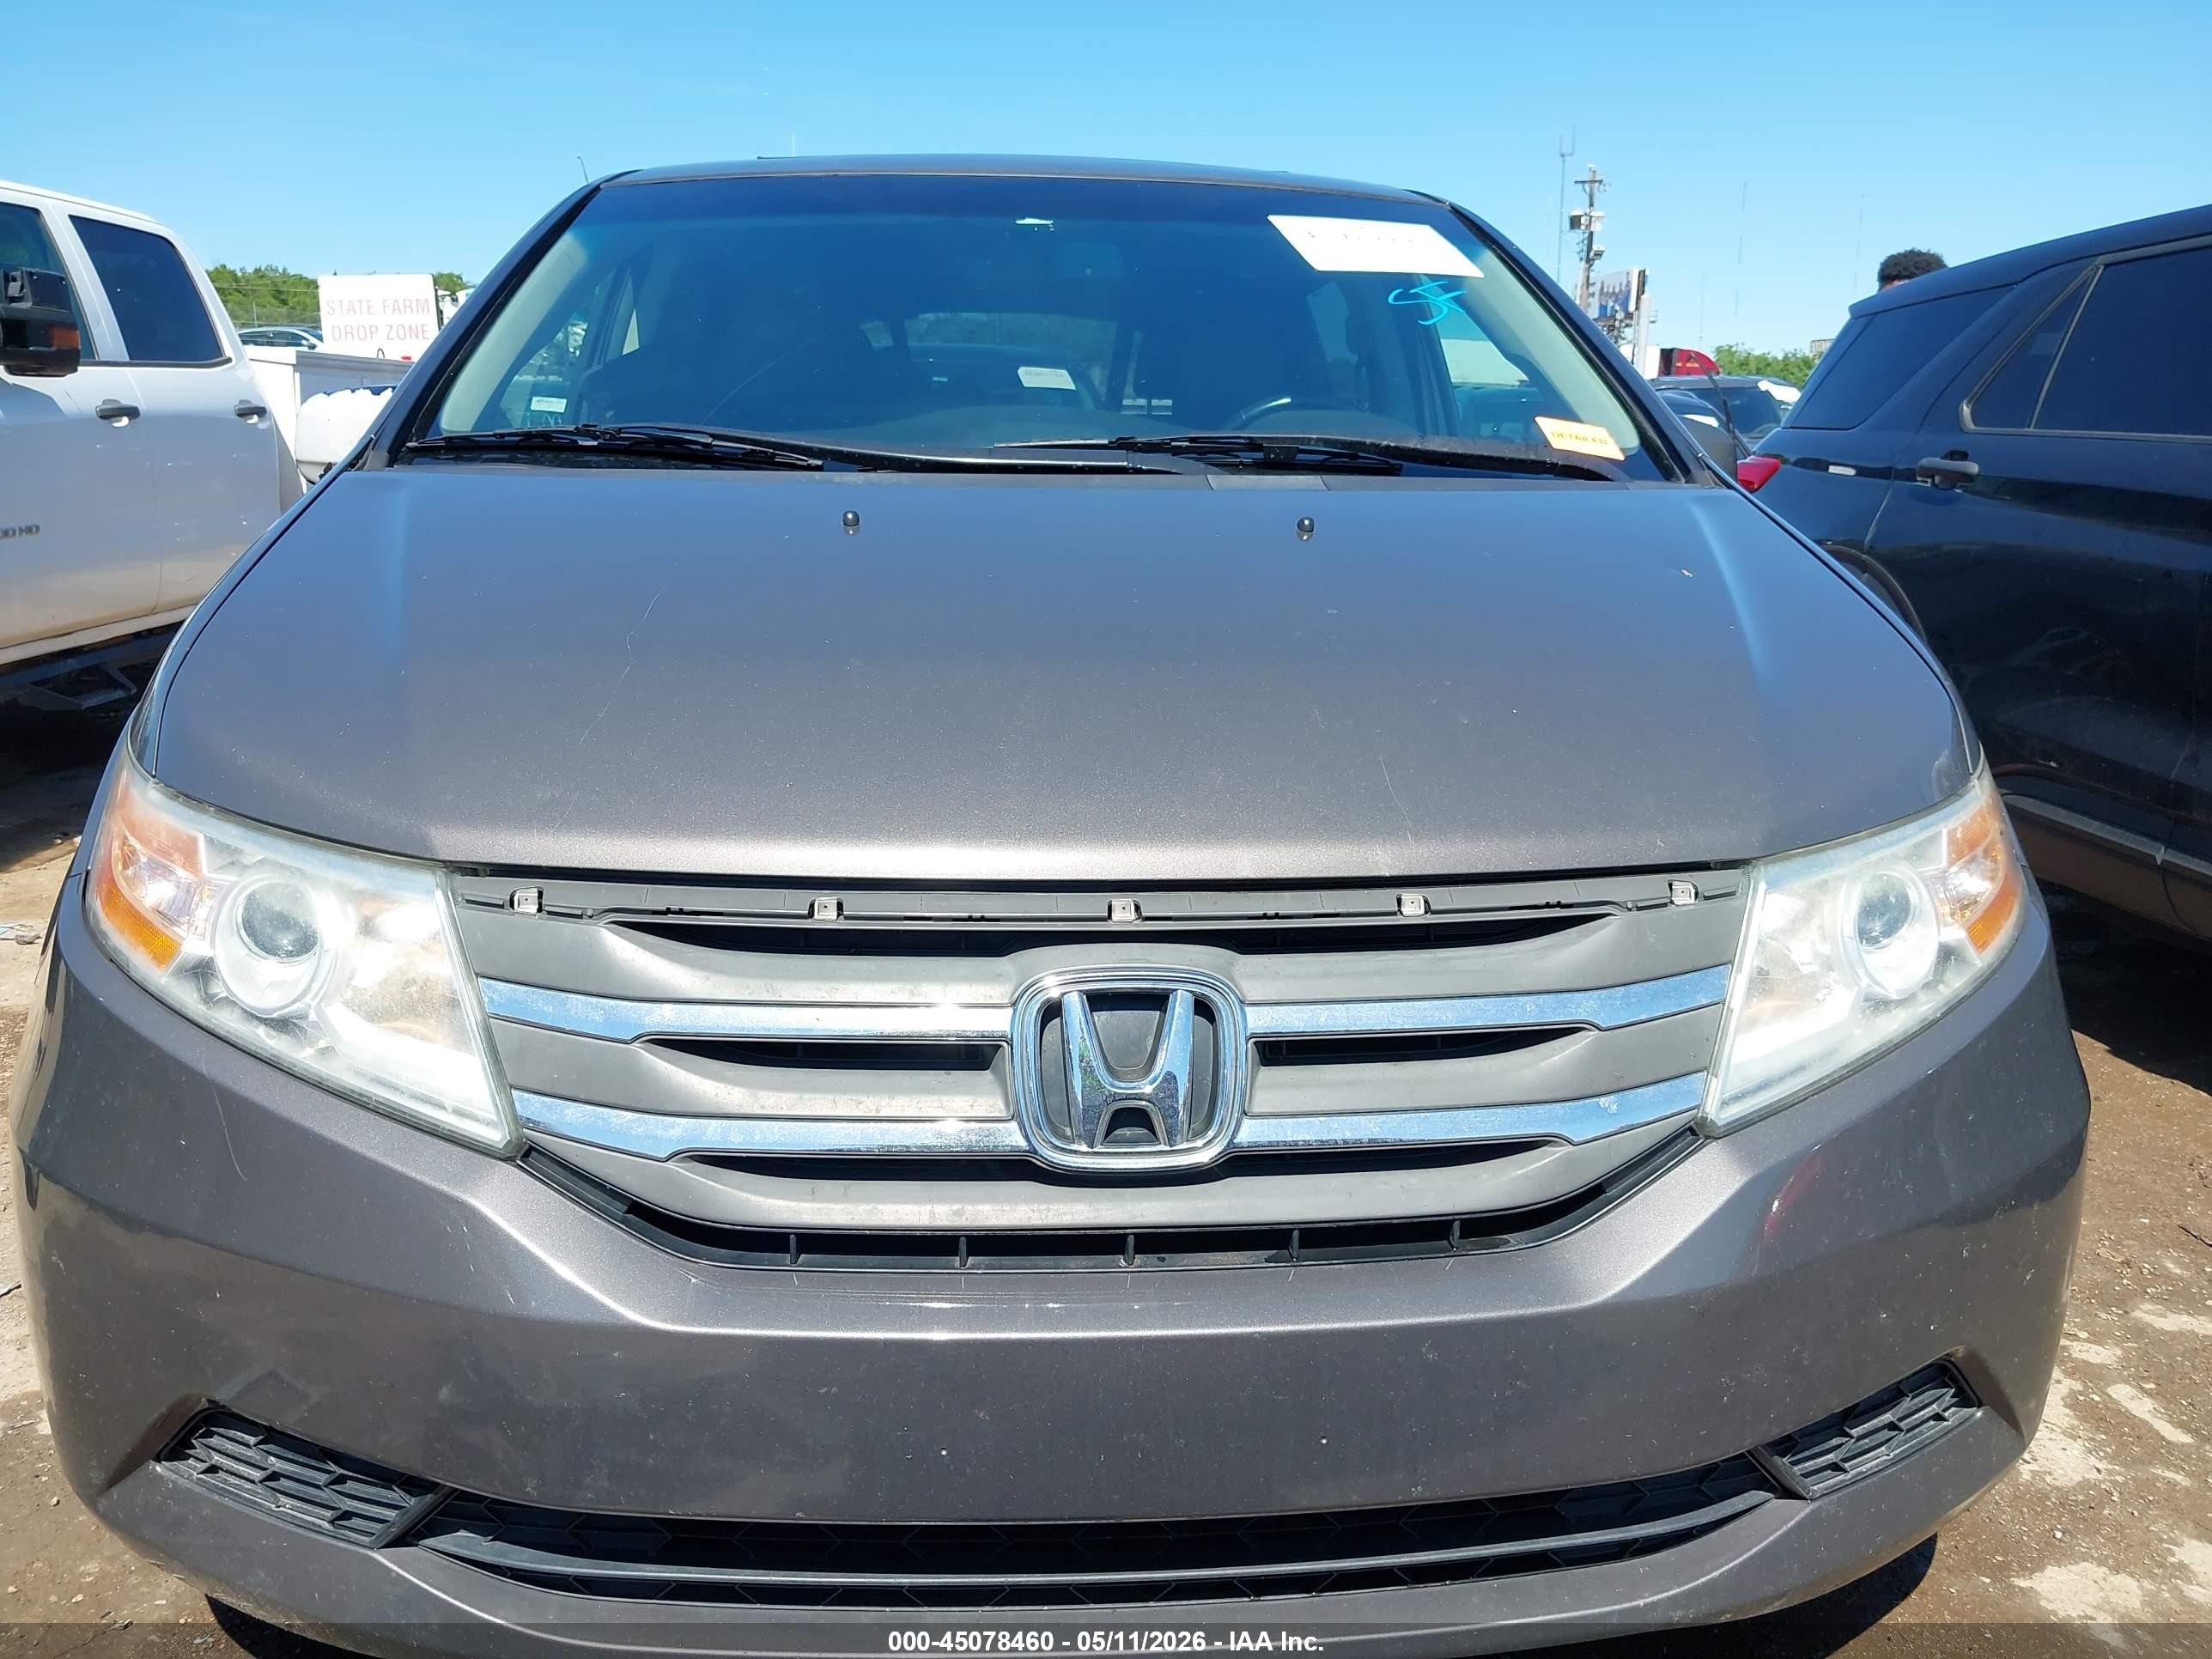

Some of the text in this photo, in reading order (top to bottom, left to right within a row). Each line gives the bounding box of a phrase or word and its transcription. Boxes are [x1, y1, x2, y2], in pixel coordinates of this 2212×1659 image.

[326, 298, 430, 316] STATE FARM
[331, 324, 430, 341] DROP ZONE
